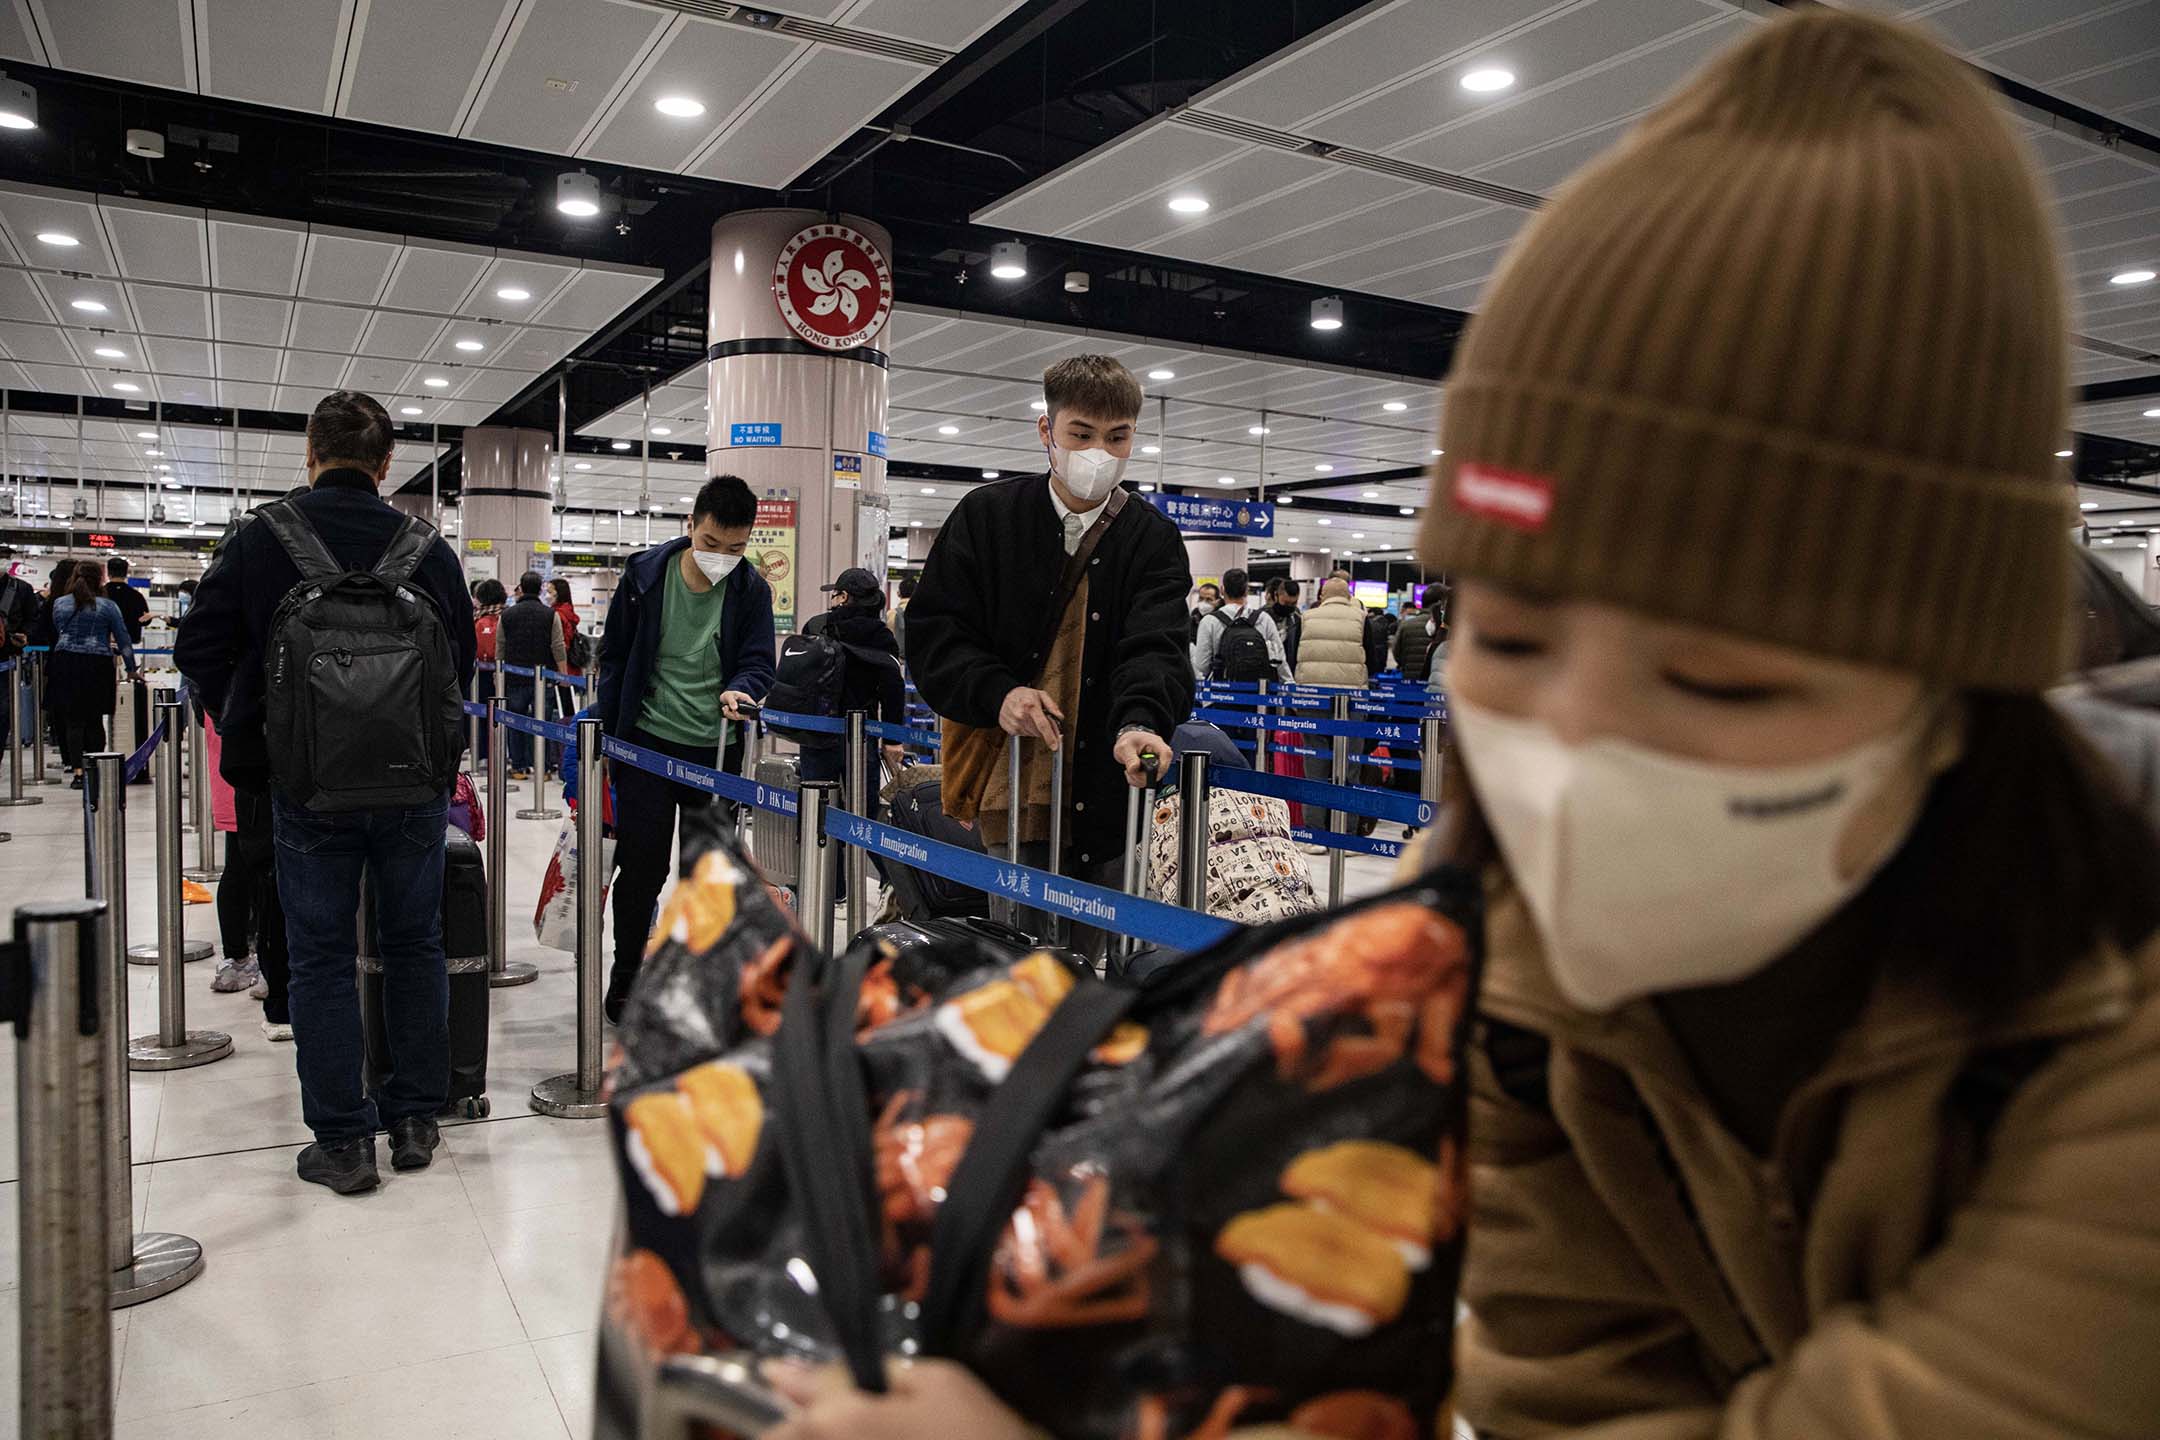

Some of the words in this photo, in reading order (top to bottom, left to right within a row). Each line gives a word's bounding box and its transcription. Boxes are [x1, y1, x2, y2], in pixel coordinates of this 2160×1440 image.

[796, 322, 830, 346] HONG
[835, 331, 868, 347] KONG
[1167, 501, 1234, 518] 警察報案中心
[1181, 517, 1211, 528] Reporting
[1212, 519, 1233, 529] Centre
[1291, 698, 1320, 706] Immigration
[1355, 702, 1385, 712] Immigration
[1244, 716, 1265, 728] 入境處
[1278, 718, 1317, 730] Immigration
[1375, 726, 1401, 738] 入境處
[676, 764, 684, 778] HK
[685, 766, 715, 788] Immigration
[769, 791, 781, 808] HK
[848, 821, 873, 845] 入境處
[880, 832, 928, 862] Immigration
[1371, 844, 1396, 856] 入境處
[995, 868, 1031, 898] 入境處
[1043, 882, 1116, 921] Immigration
